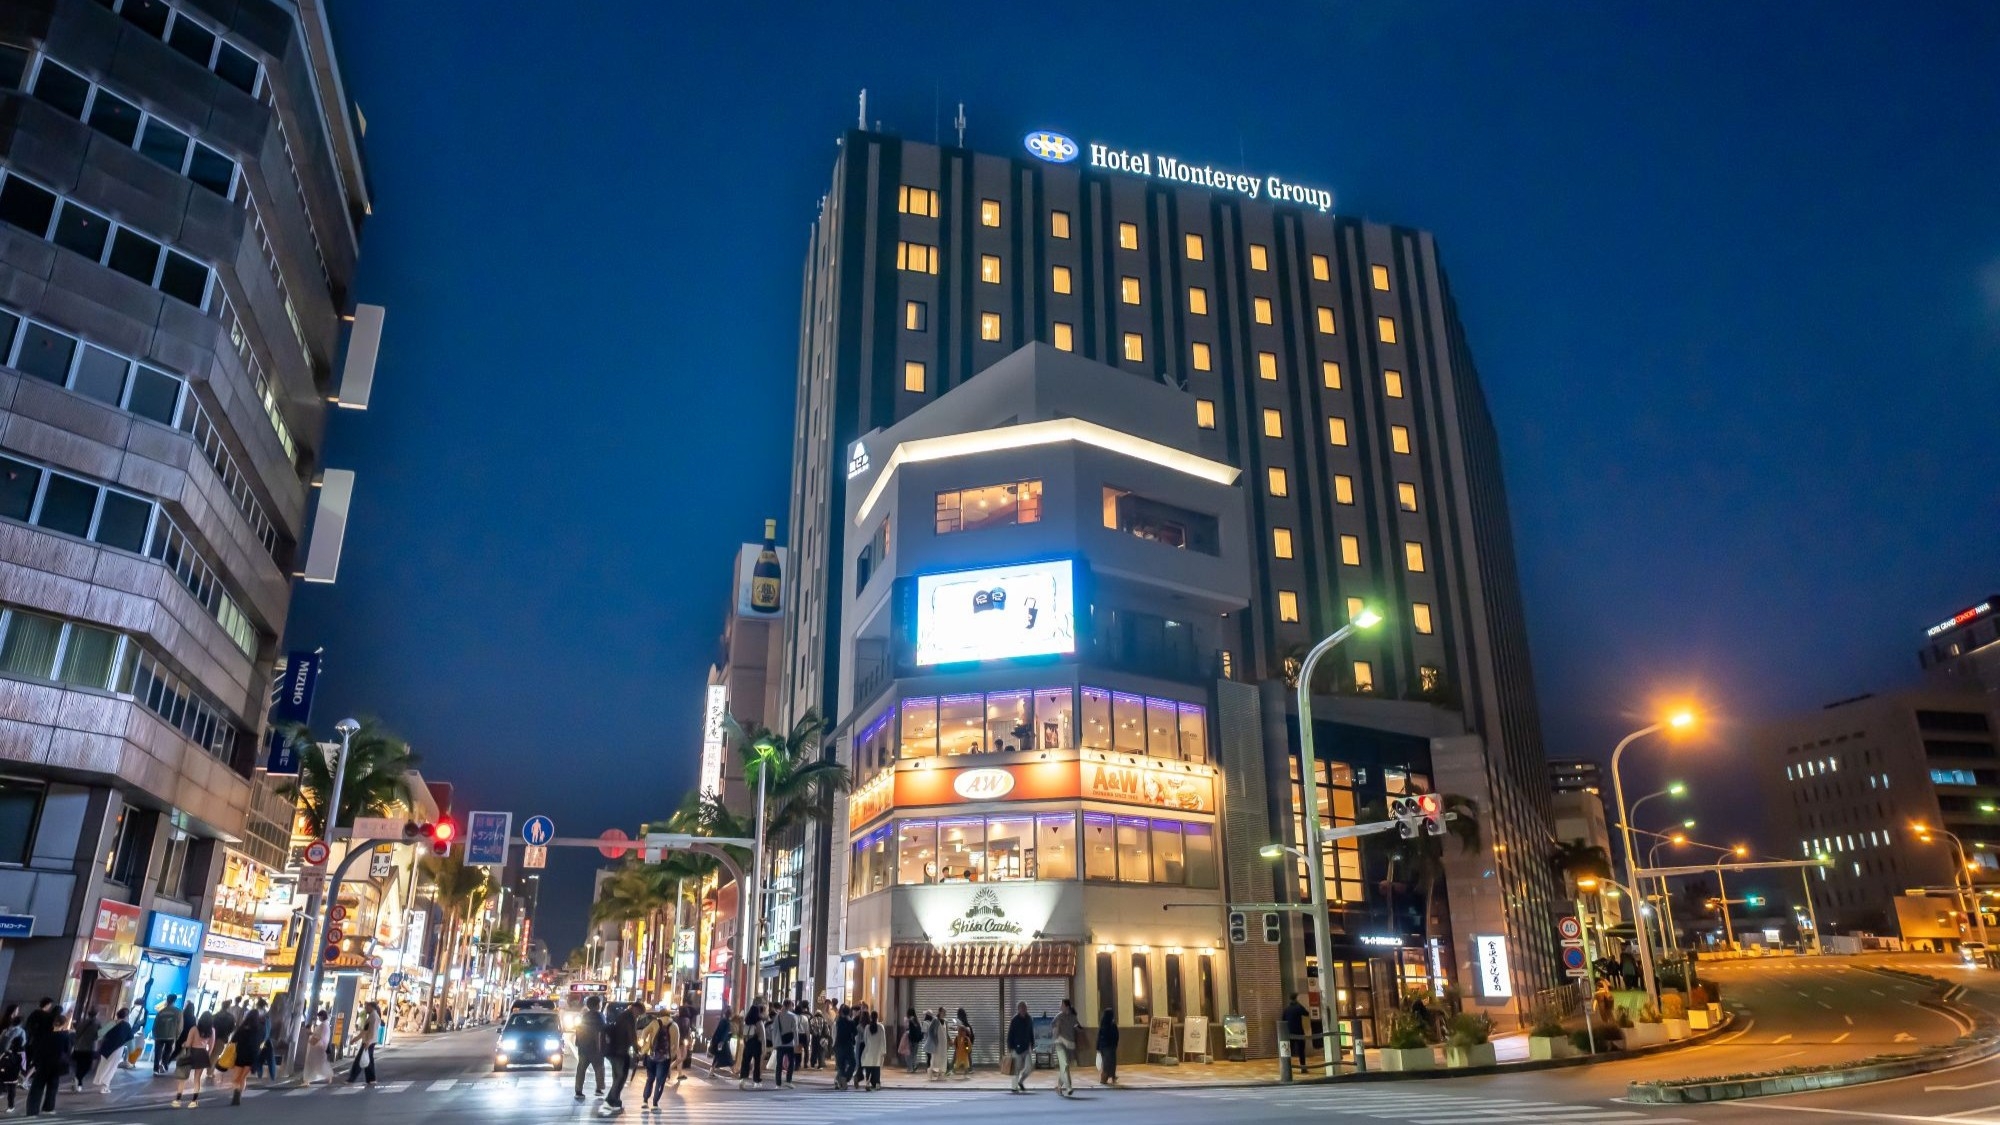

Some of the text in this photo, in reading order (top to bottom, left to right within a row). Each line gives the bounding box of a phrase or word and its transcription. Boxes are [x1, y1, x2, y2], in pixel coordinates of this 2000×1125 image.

[1090, 143, 1332, 212] Hotel Monterey Group
[1927, 627, 1942, 637] HOTEL
[1940, 618, 1956, 630] GRAND
[1975, 602, 1990, 614] NAHA
[292, 660, 310, 705] MIZUHO
[1093, 766, 1138, 794] A&W
[1564, 923, 1576, 933] 40
